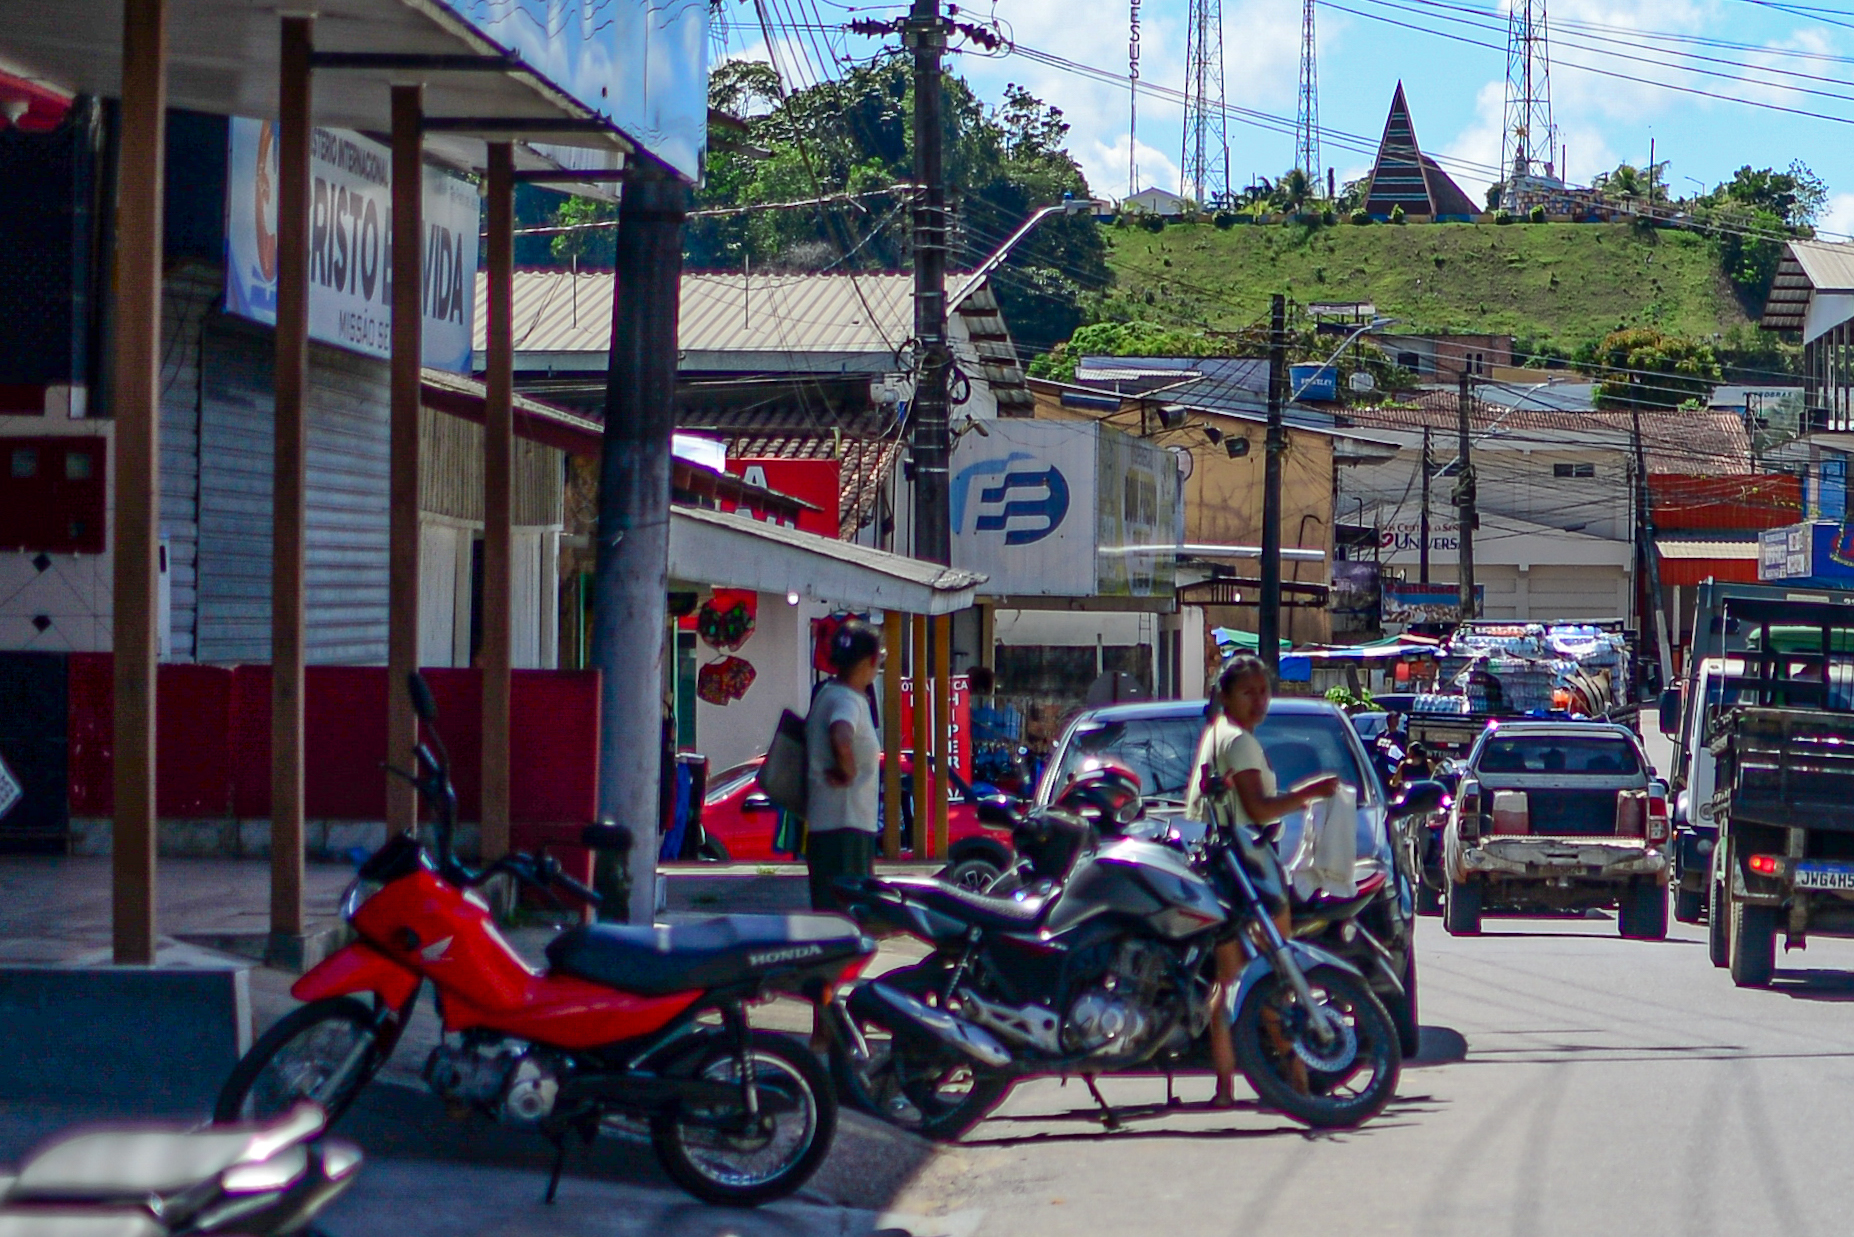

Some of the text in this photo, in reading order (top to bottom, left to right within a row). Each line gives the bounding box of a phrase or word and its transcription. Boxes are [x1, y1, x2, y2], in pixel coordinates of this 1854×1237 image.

[311, 178, 379, 302] RISTO
[378, 320, 391, 352] SE
[1395, 533, 1460, 550] UNERS
[749, 944, 824, 966] HONDA
